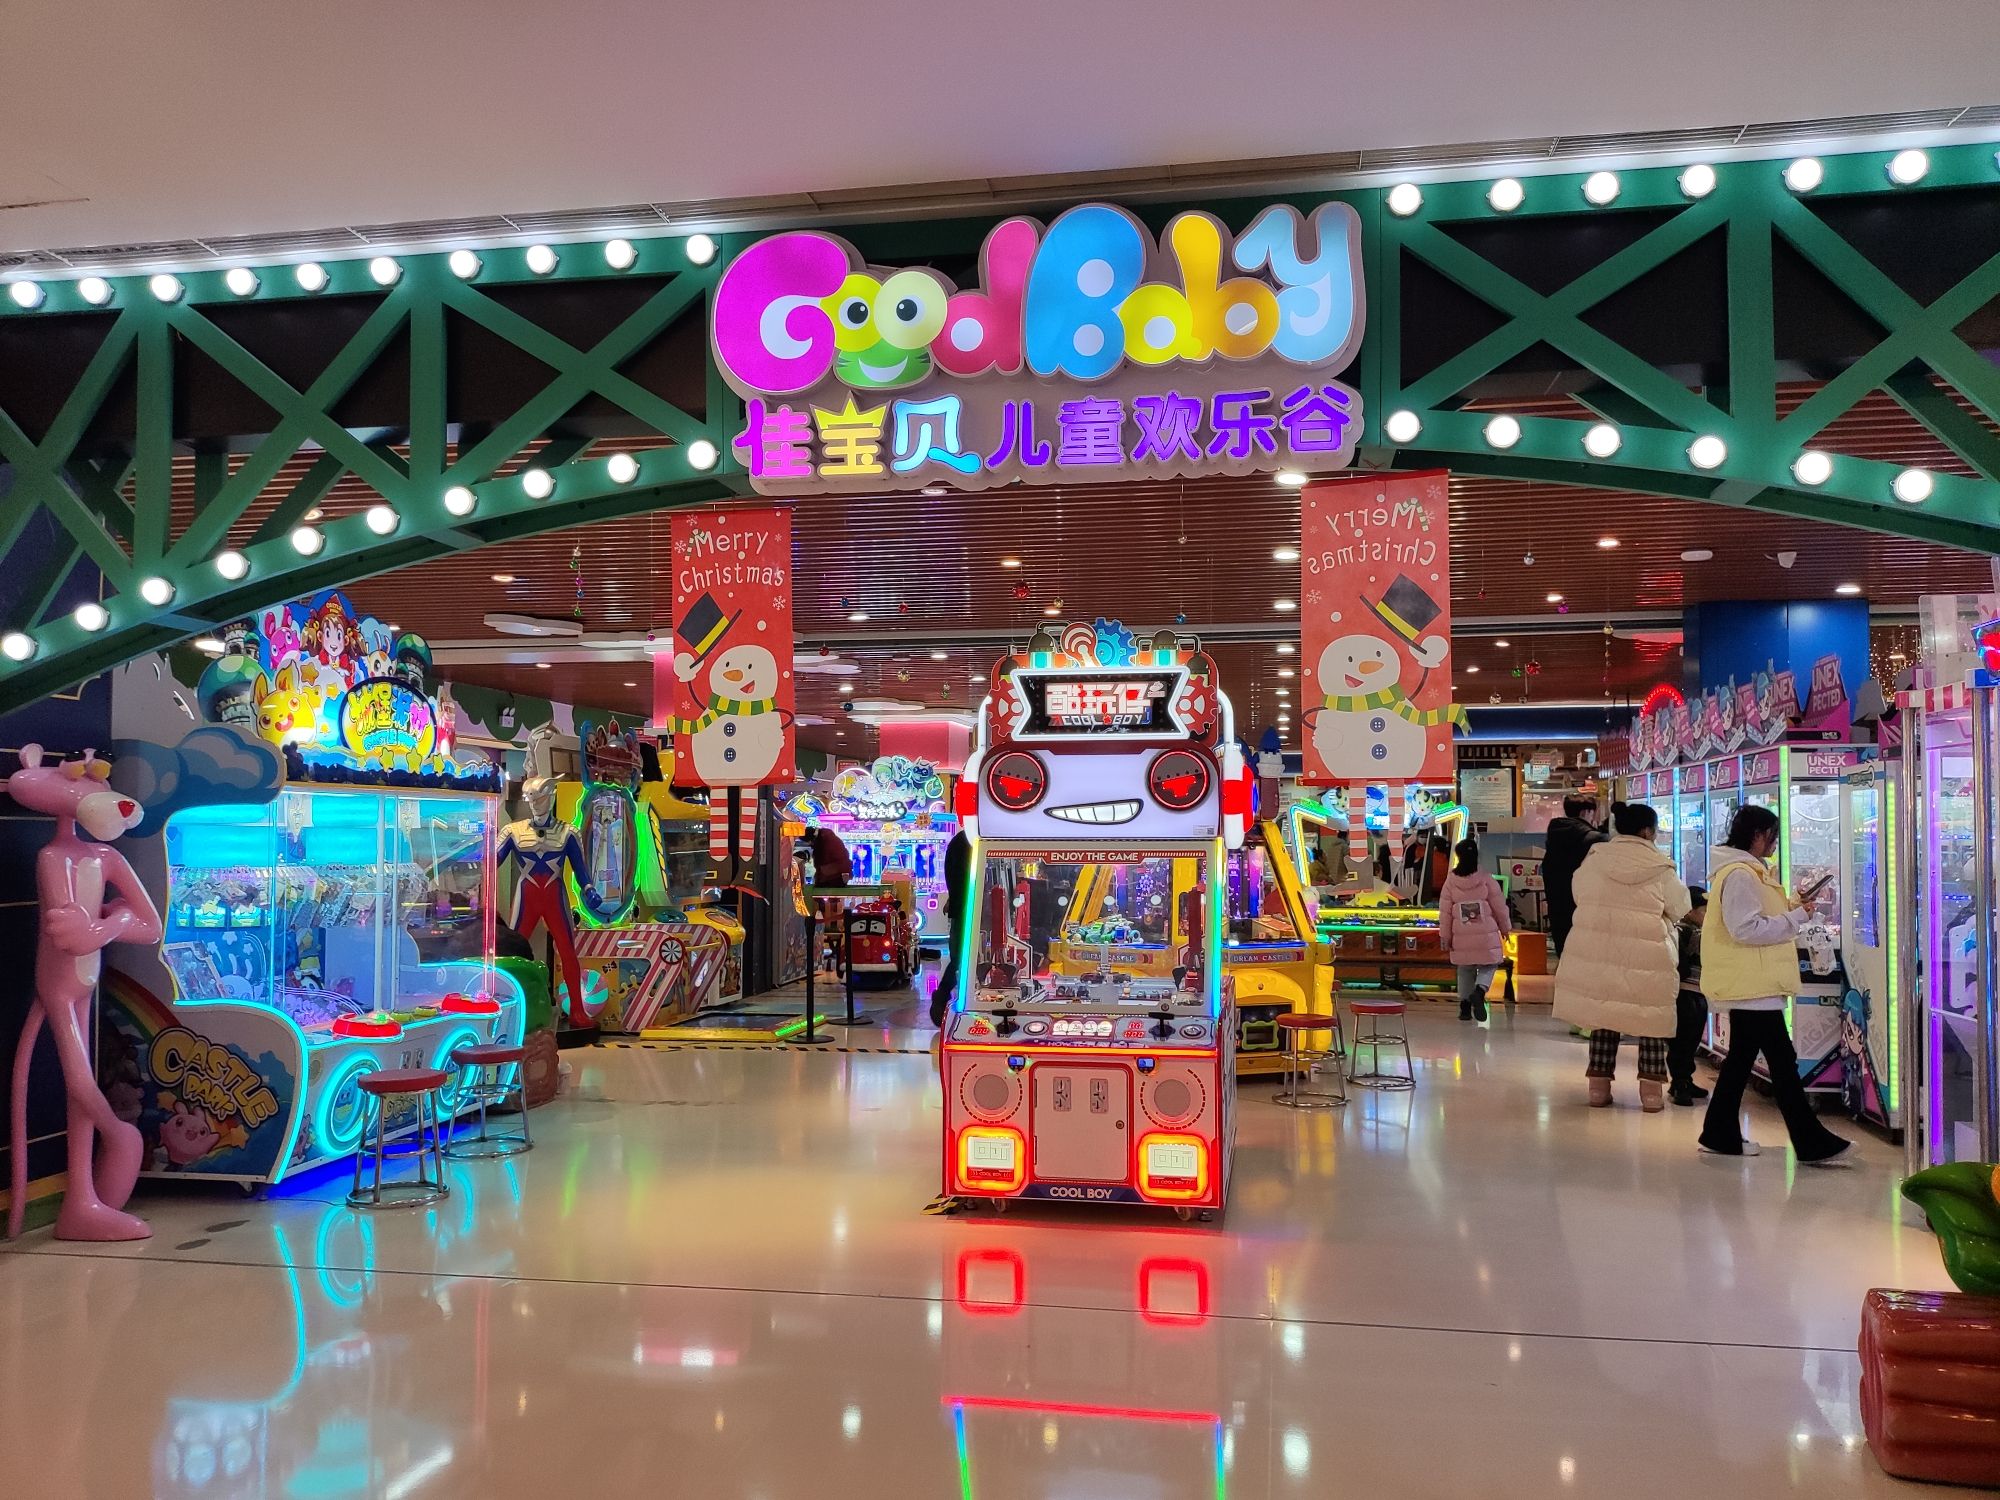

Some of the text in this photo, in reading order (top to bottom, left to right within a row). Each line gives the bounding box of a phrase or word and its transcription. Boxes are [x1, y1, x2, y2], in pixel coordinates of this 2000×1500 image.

[694, 531, 769, 557] Merry
[680, 562, 785, 593] Christmas
[1811, 660, 1840, 693] UNEX
[1061, 715, 1142, 725] COOL BOY
[1809, 755, 1846, 766] UNEX
[1050, 852, 1139, 861] ENJOY THE GAME
[150, 1028, 278, 1126] CASTLE
[1050, 1187, 1112, 1199] COOL BOY
